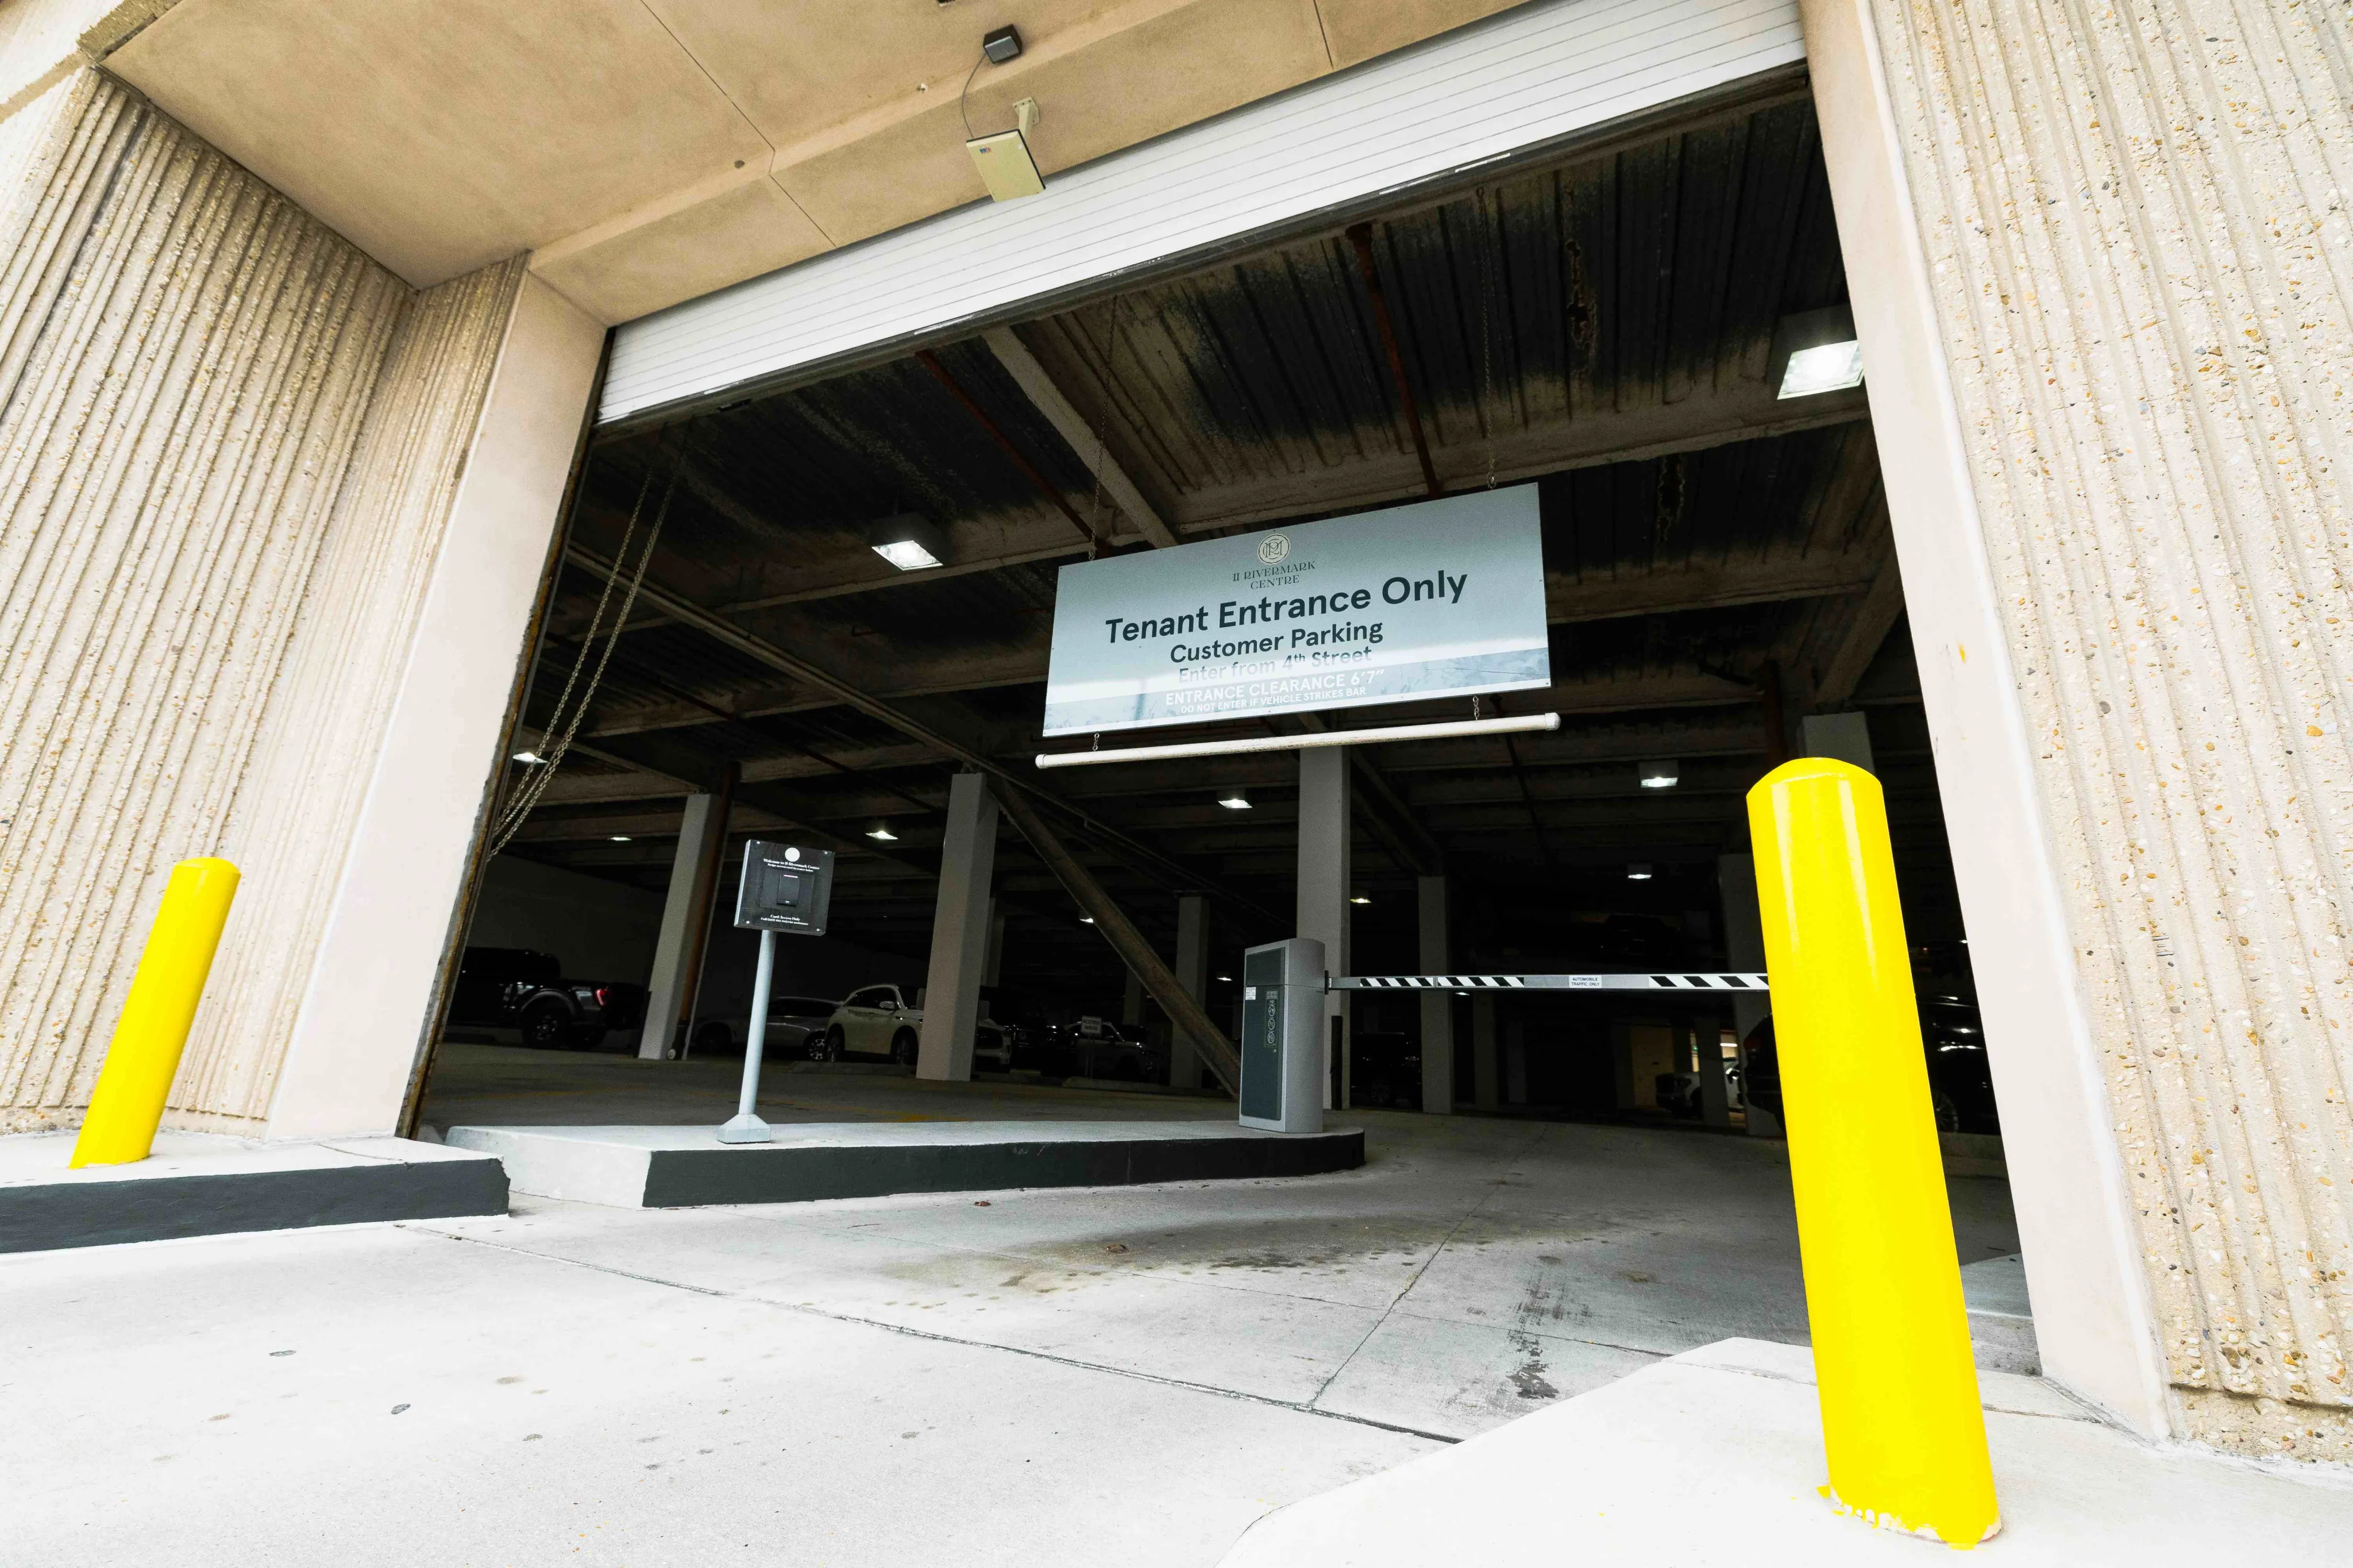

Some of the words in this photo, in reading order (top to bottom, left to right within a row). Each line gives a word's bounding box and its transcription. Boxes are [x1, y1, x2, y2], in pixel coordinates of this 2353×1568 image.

[1233, 573, 1240, 581] II
[1244, 561, 1316, 580] RIVERMARK
[1251, 575, 1299, 589] CENTRE
[1105, 606, 1208, 643] Tenant
[1219, 589, 1371, 628] Entrance
[1382, 570, 1468, 604] Only
[1170, 635, 1284, 663] Customer
[1291, 621, 1383, 648] Parking
[1179, 666, 1226, 683] Enter
[1231, 662, 1275, 677] from
[1282, 654, 1305, 670] 4th
[1311, 646, 1372, 667] Street
[1166, 685, 1245, 705] ENTRANCE
[1249, 674, 1345, 696] CLEARANCE
[1181, 705, 1194, 713] DO
[1197, 702, 1217, 712] NOT
[1218, 700, 1247, 710] ENTER
[1249, 698, 1259, 706] IF
[1260, 693, 1302, 705] VEHICLE
[1303, 689, 1344, 701] STRIKES
[1346, 686, 1367, 697] BAR
